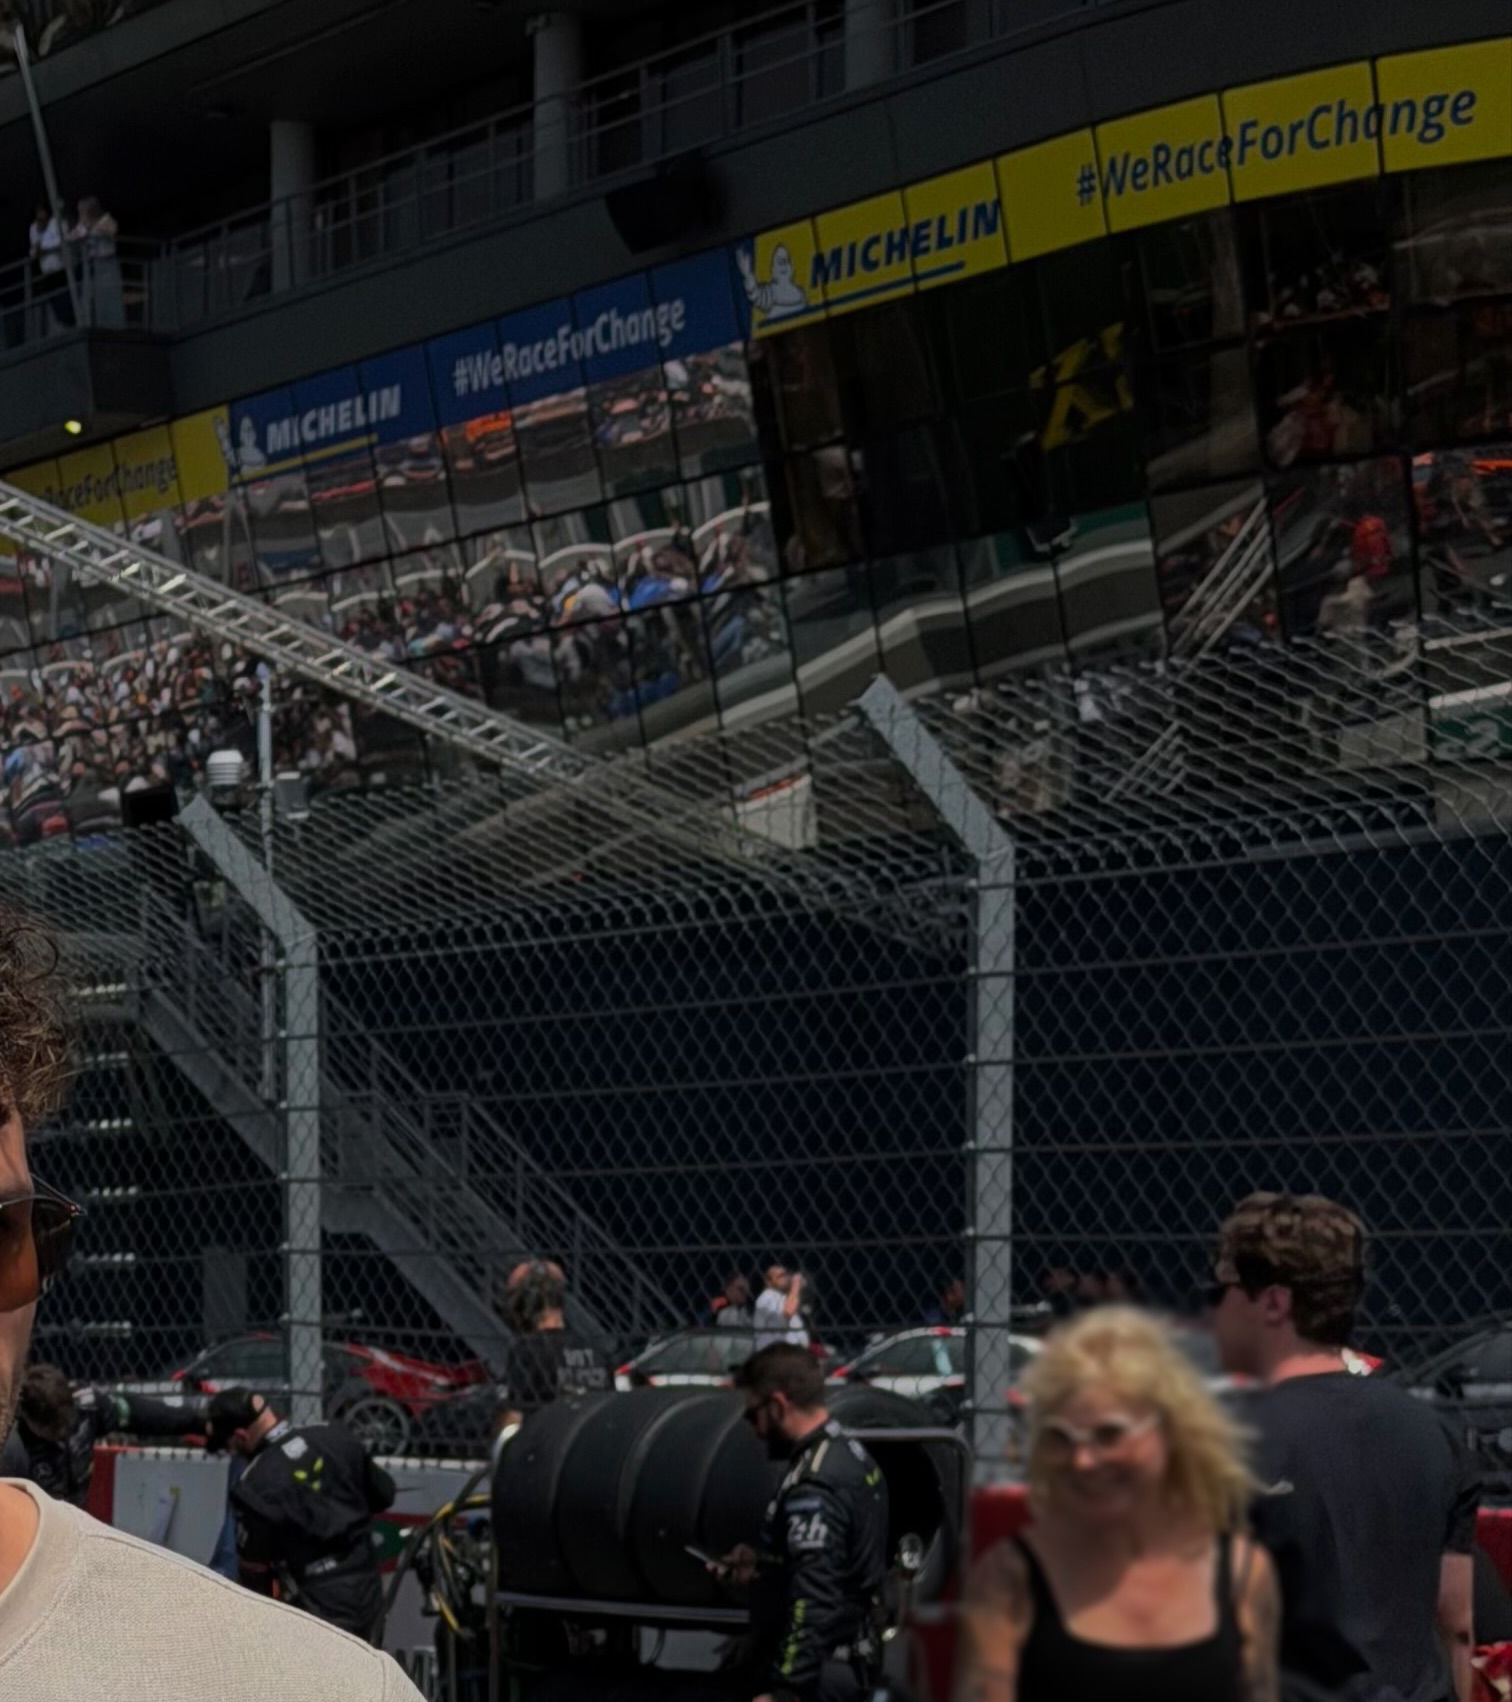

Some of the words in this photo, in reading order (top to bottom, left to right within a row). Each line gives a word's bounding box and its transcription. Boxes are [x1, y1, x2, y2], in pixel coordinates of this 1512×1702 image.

[810, 200, 1001, 290] MICHELIN
[1076, 88, 1478, 207] #WeRaceForChange
[266, 384, 402, 454] MICHELIN
[452, 298, 686, 397] #WeRaceForChange
